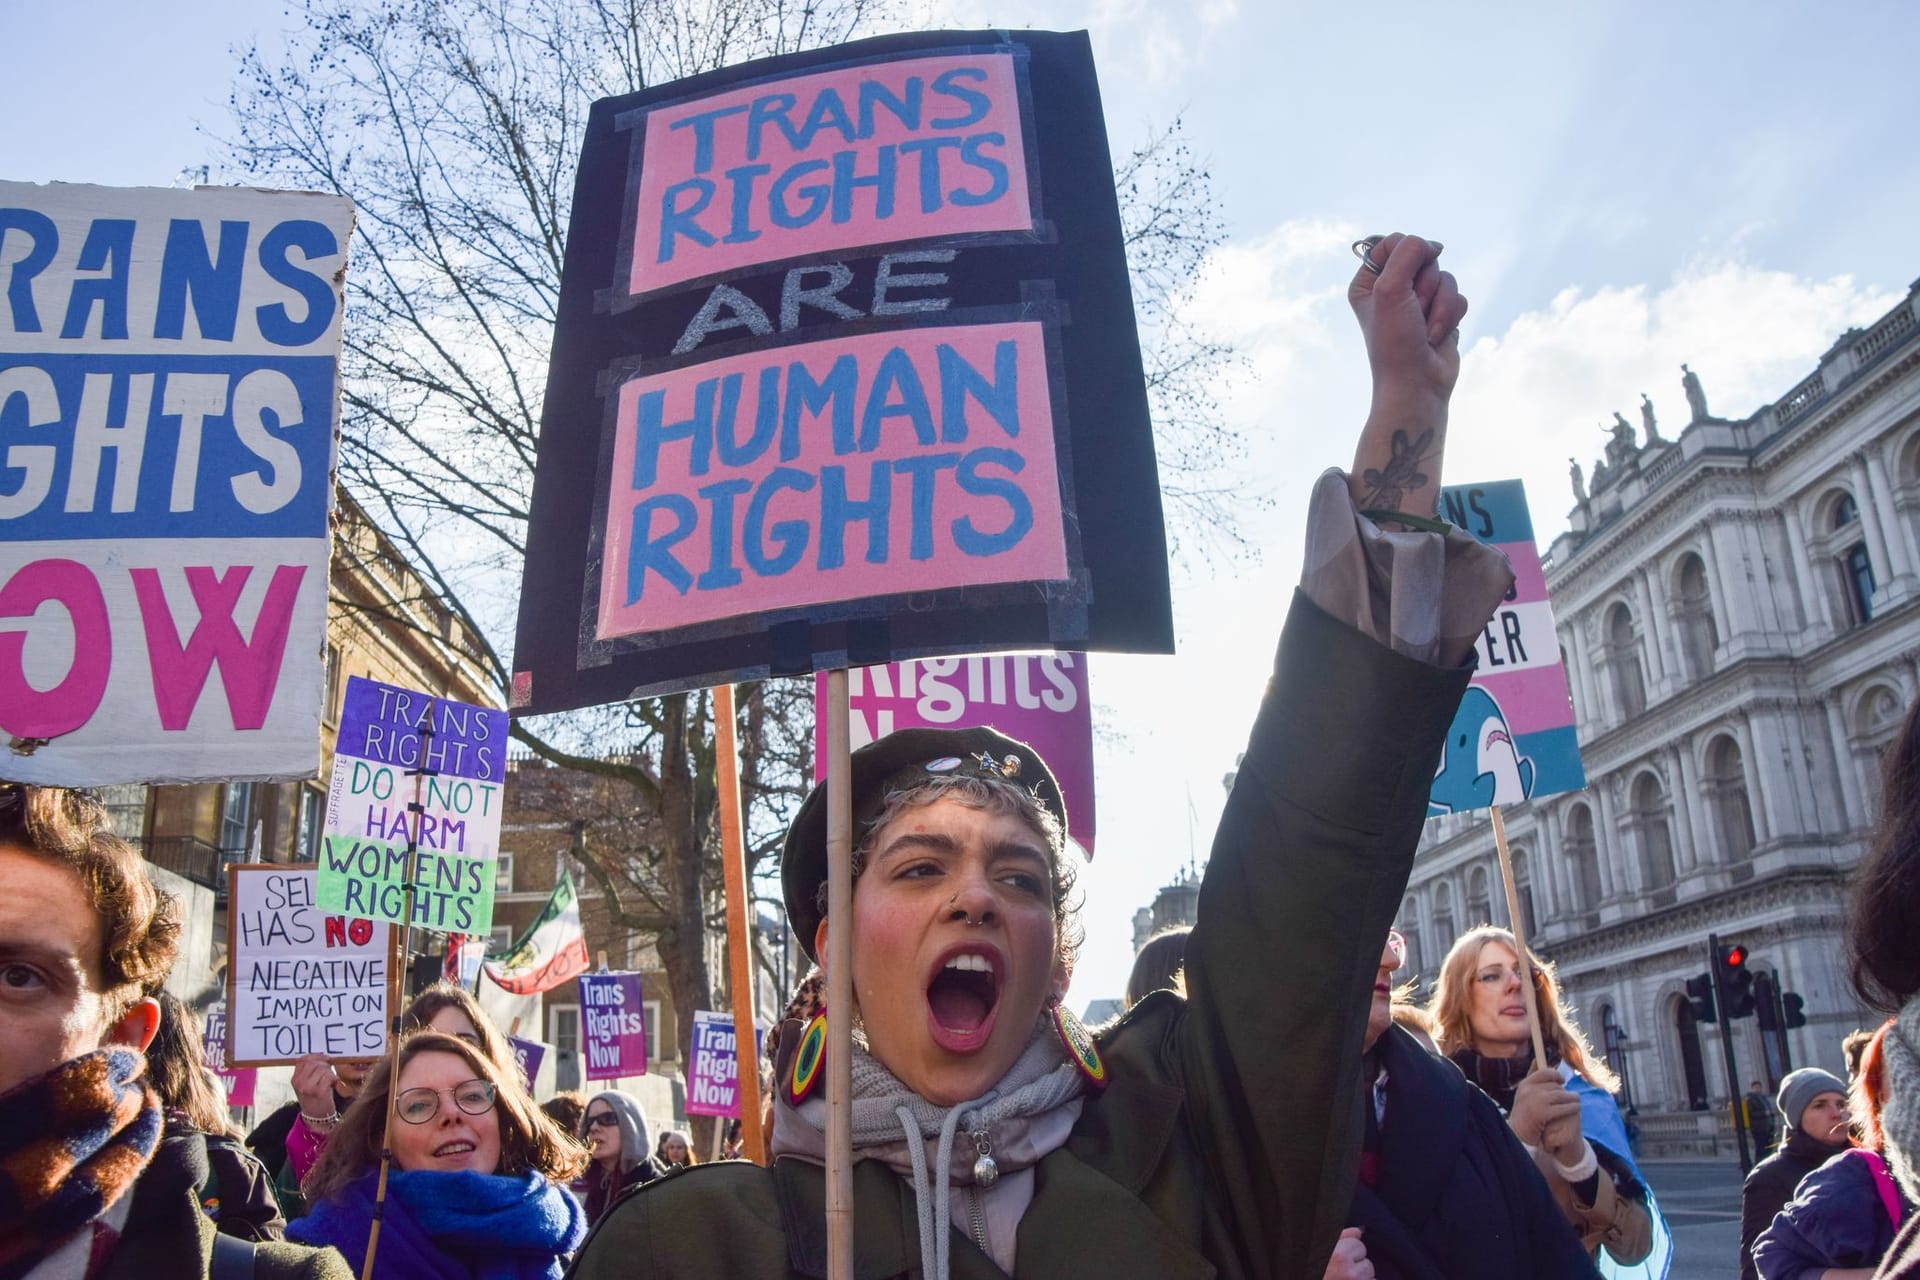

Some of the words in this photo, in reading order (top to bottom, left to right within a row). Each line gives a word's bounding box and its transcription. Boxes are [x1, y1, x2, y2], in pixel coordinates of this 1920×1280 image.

[670, 67, 992, 175] TRANS
[656, 132, 1009, 264] RIGHTS
[671, 249, 962, 356] ARE
[631, 339, 1018, 491] HUMAN
[622, 447, 1033, 608] RIGHTS
[378, 687, 489, 741] TRANS
[364, 724, 492, 780] RIGHTS
[327, 757, 347, 826] SUFFRAGETTE
[351, 761, 394, 801] DO
[428, 776, 497, 816] NOT
[366, 804, 465, 852] HARM
[325, 837, 484, 894] WOMEN'S
[241, 908, 315, 946] HAS
[325, 915, 374, 948] NO
[345, 878, 474, 930] RIGHTS
[251, 960, 384, 992] NEGATIVE
[581, 977, 625, 1005] Trans
[256, 992, 347, 1020] IMPACT
[352, 994, 382, 1013] ON
[586, 1008, 642, 1043] Rights
[252, 1020, 383, 1056] TOILETS
[589, 1039, 620, 1068] Now
[693, 1077, 734, 1106] Now
